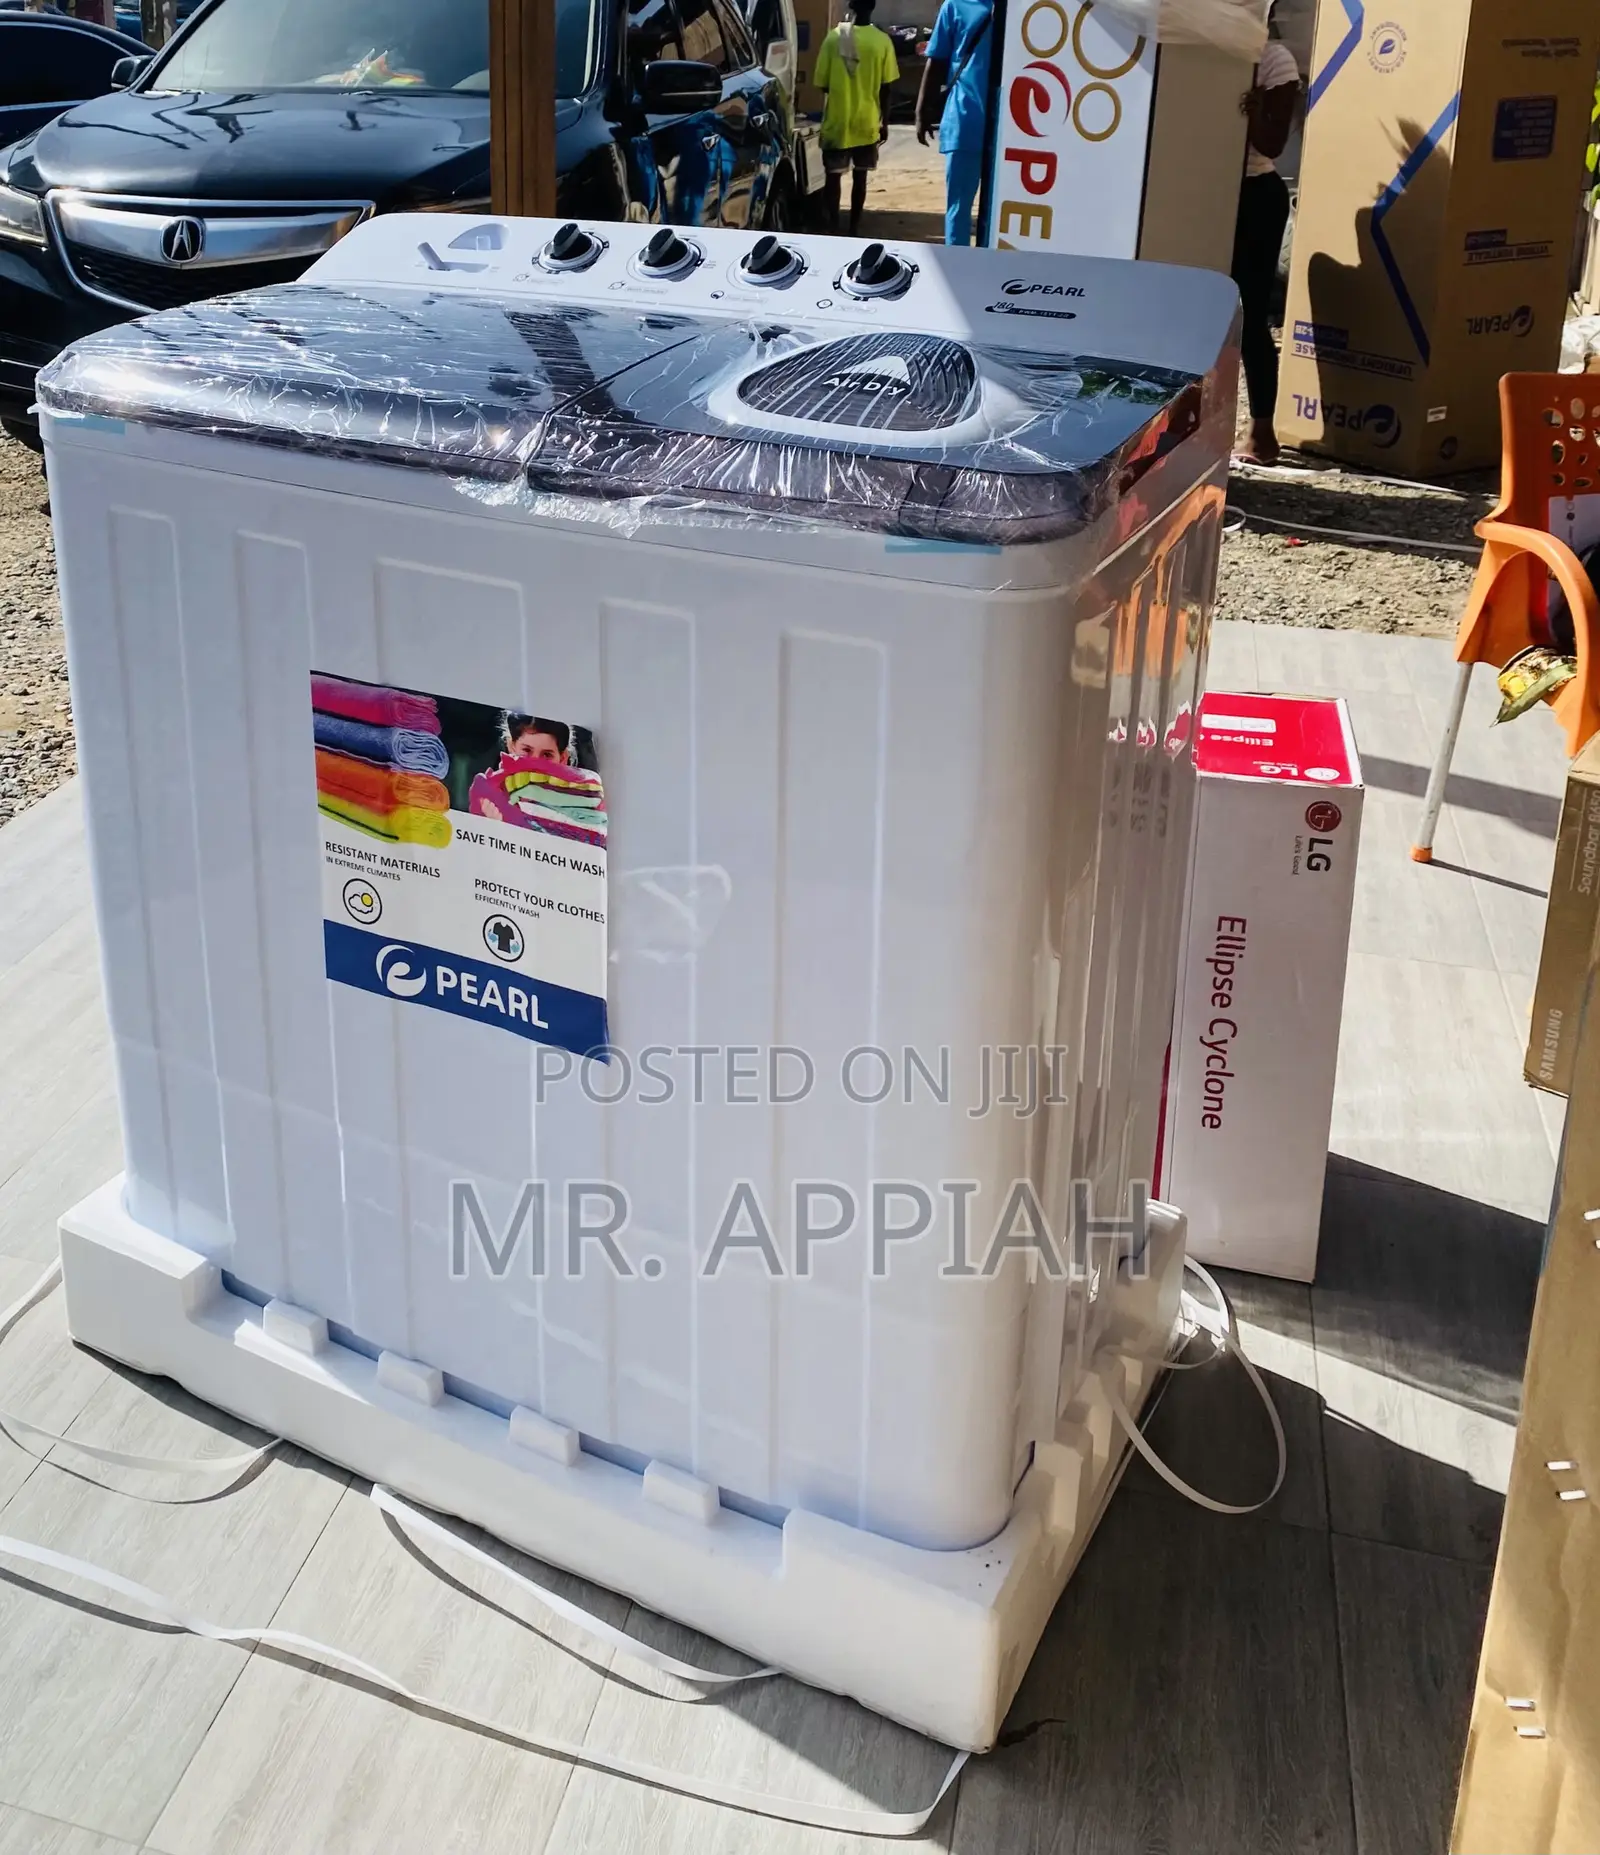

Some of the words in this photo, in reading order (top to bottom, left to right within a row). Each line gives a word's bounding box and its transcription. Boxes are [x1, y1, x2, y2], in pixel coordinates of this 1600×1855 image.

[998, 147, 1058, 250] PE
[993, 301, 1015, 310] 180
[1029, 284, 1086, 297] PEARL
[1466, 314, 1511, 335] PEARL
[823, 377, 861, 388] Air
[863, 381, 906, 396] Dry
[1292, 394, 1362, 432] PEARL
[1211, 735, 1273, 746] Ellipse
[1259, 765, 1299, 777] LG
[325, 841, 379, 865] RESISTANT
[380, 854, 441, 879] MATERIALS
[325, 856, 333, 864] IN
[334, 858, 365, 872] EXTREME
[366, 866, 401, 882] CLIMATES
[455, 828, 486, 847] SAVE
[488, 835, 516, 855] TIME
[519, 843, 532, 859] IN
[534, 846, 567, 867] EACH
[569, 853, 605, 879] WASH
[1306, 837, 1334, 872] LG
[1577, 824, 1598, 896] Soundbar
[474, 878, 521, 901] PROTECT
[522, 889, 555, 911] YOUR
[557, 899, 605, 924] CLOTHES
[474, 892, 517, 912] EFFICIENTLY
[518, 905, 540, 919] WASH
[1205, 915, 1247, 1009] Ellipse
[436, 965, 549, 1029] PEARL
[1539, 1008, 1564, 1081] SAMSUNG
[1200, 1016, 1238, 1130] Cyclone
